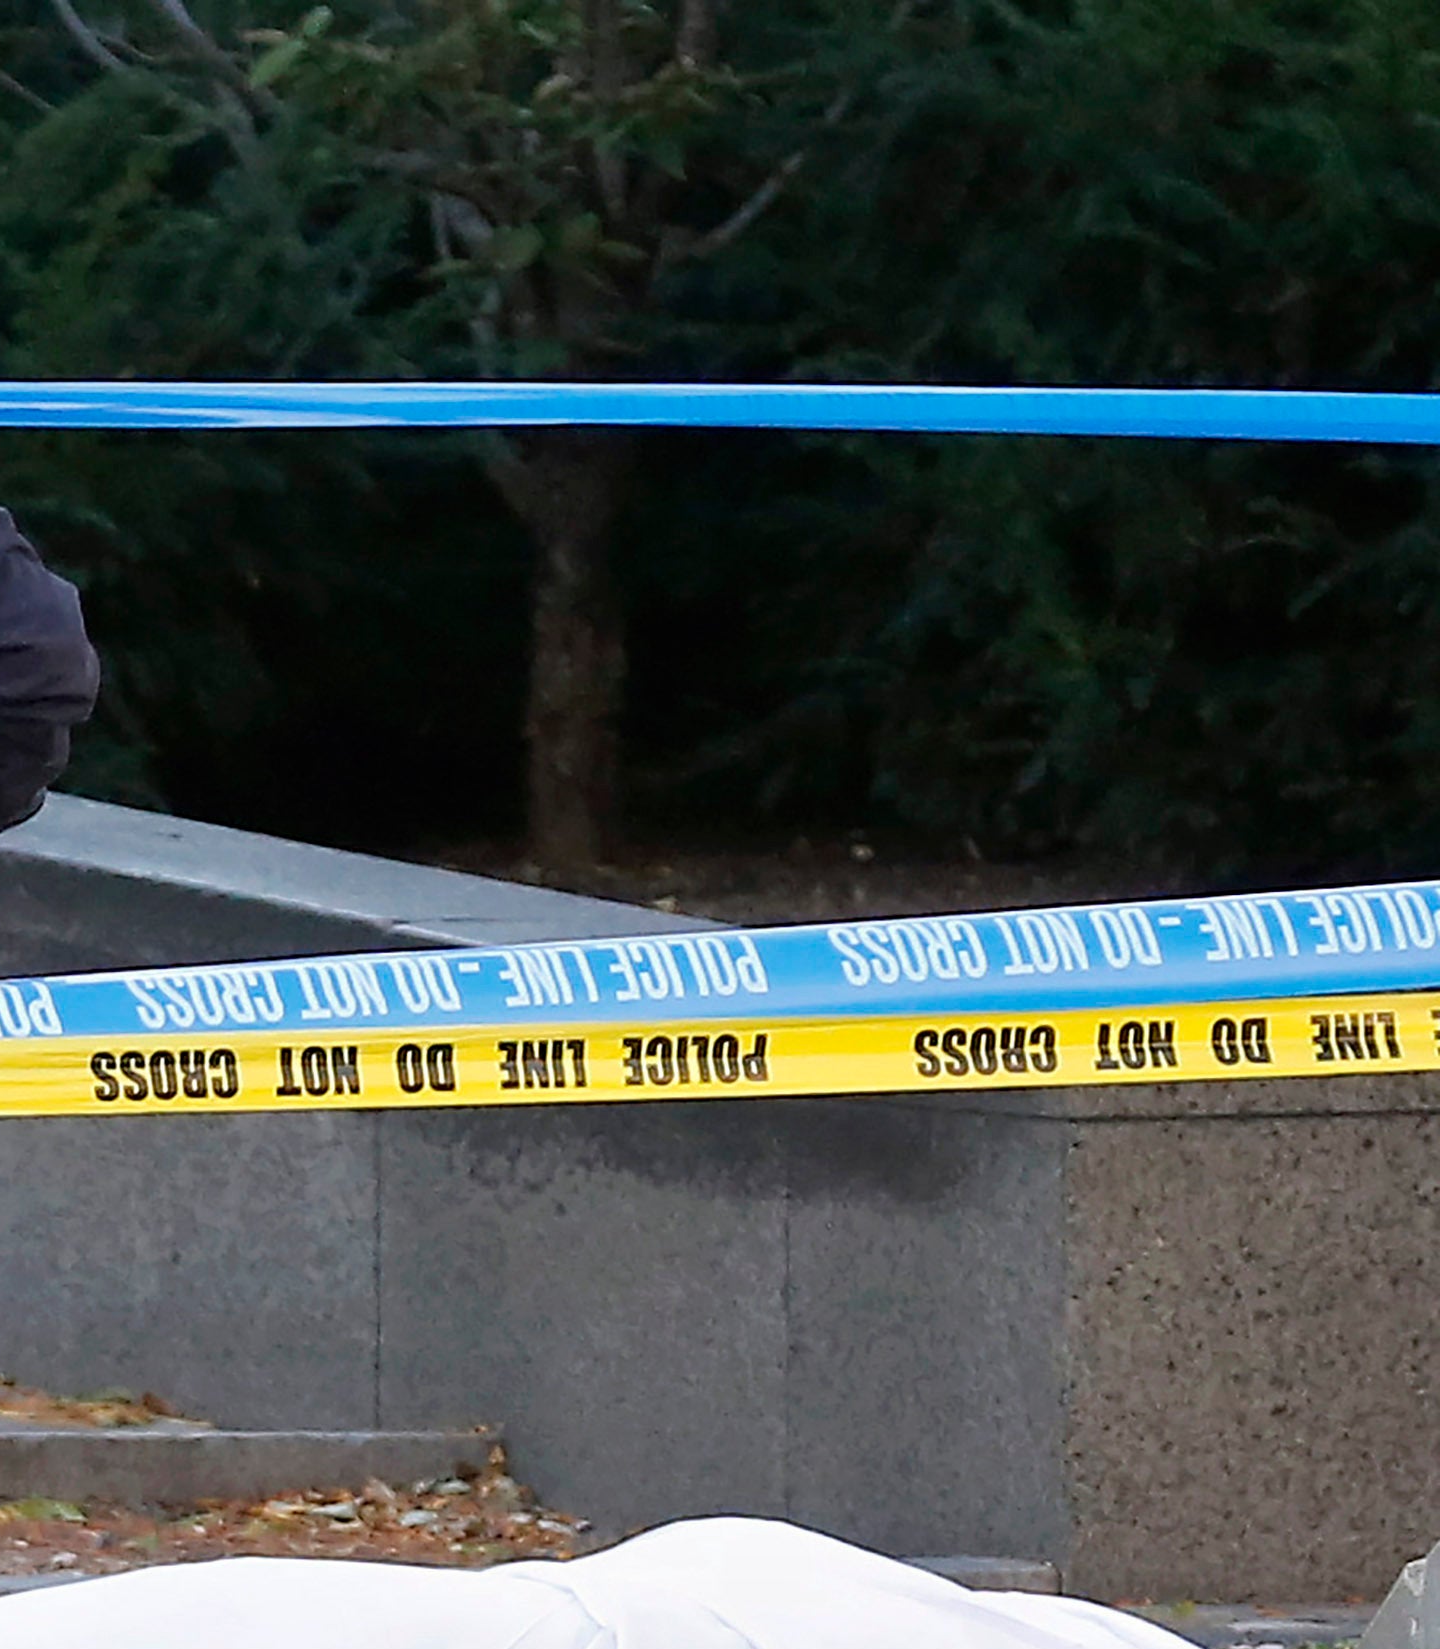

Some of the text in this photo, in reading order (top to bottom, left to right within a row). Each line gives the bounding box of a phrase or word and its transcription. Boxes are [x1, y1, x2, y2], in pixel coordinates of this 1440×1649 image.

[994, 912, 1089, 976] NOT
[1088, 906, 1163, 970] DO
[1186, 897, 1299, 961] LINE
[1295, 886, 1440, 955] OLICE
[392, 955, 462, 1013] DO
[495, 945, 599, 1007] LINE
[596, 935, 769, 1001] POLICE
[828, 920, 988, 987] CROSS
[126, 969, 285, 1029] CROSS
[293, 958, 389, 1019] NOT
[90, 1033, 769, 1102] POLICE LINE DO NOT CROSS
[914, 1024, 1058, 1078] CROSS
[1095, 1021, 1178, 1070] NOT
[1212, 1017, 1273, 1065] DO
[1310, 1012, 1402, 1062] LINE
